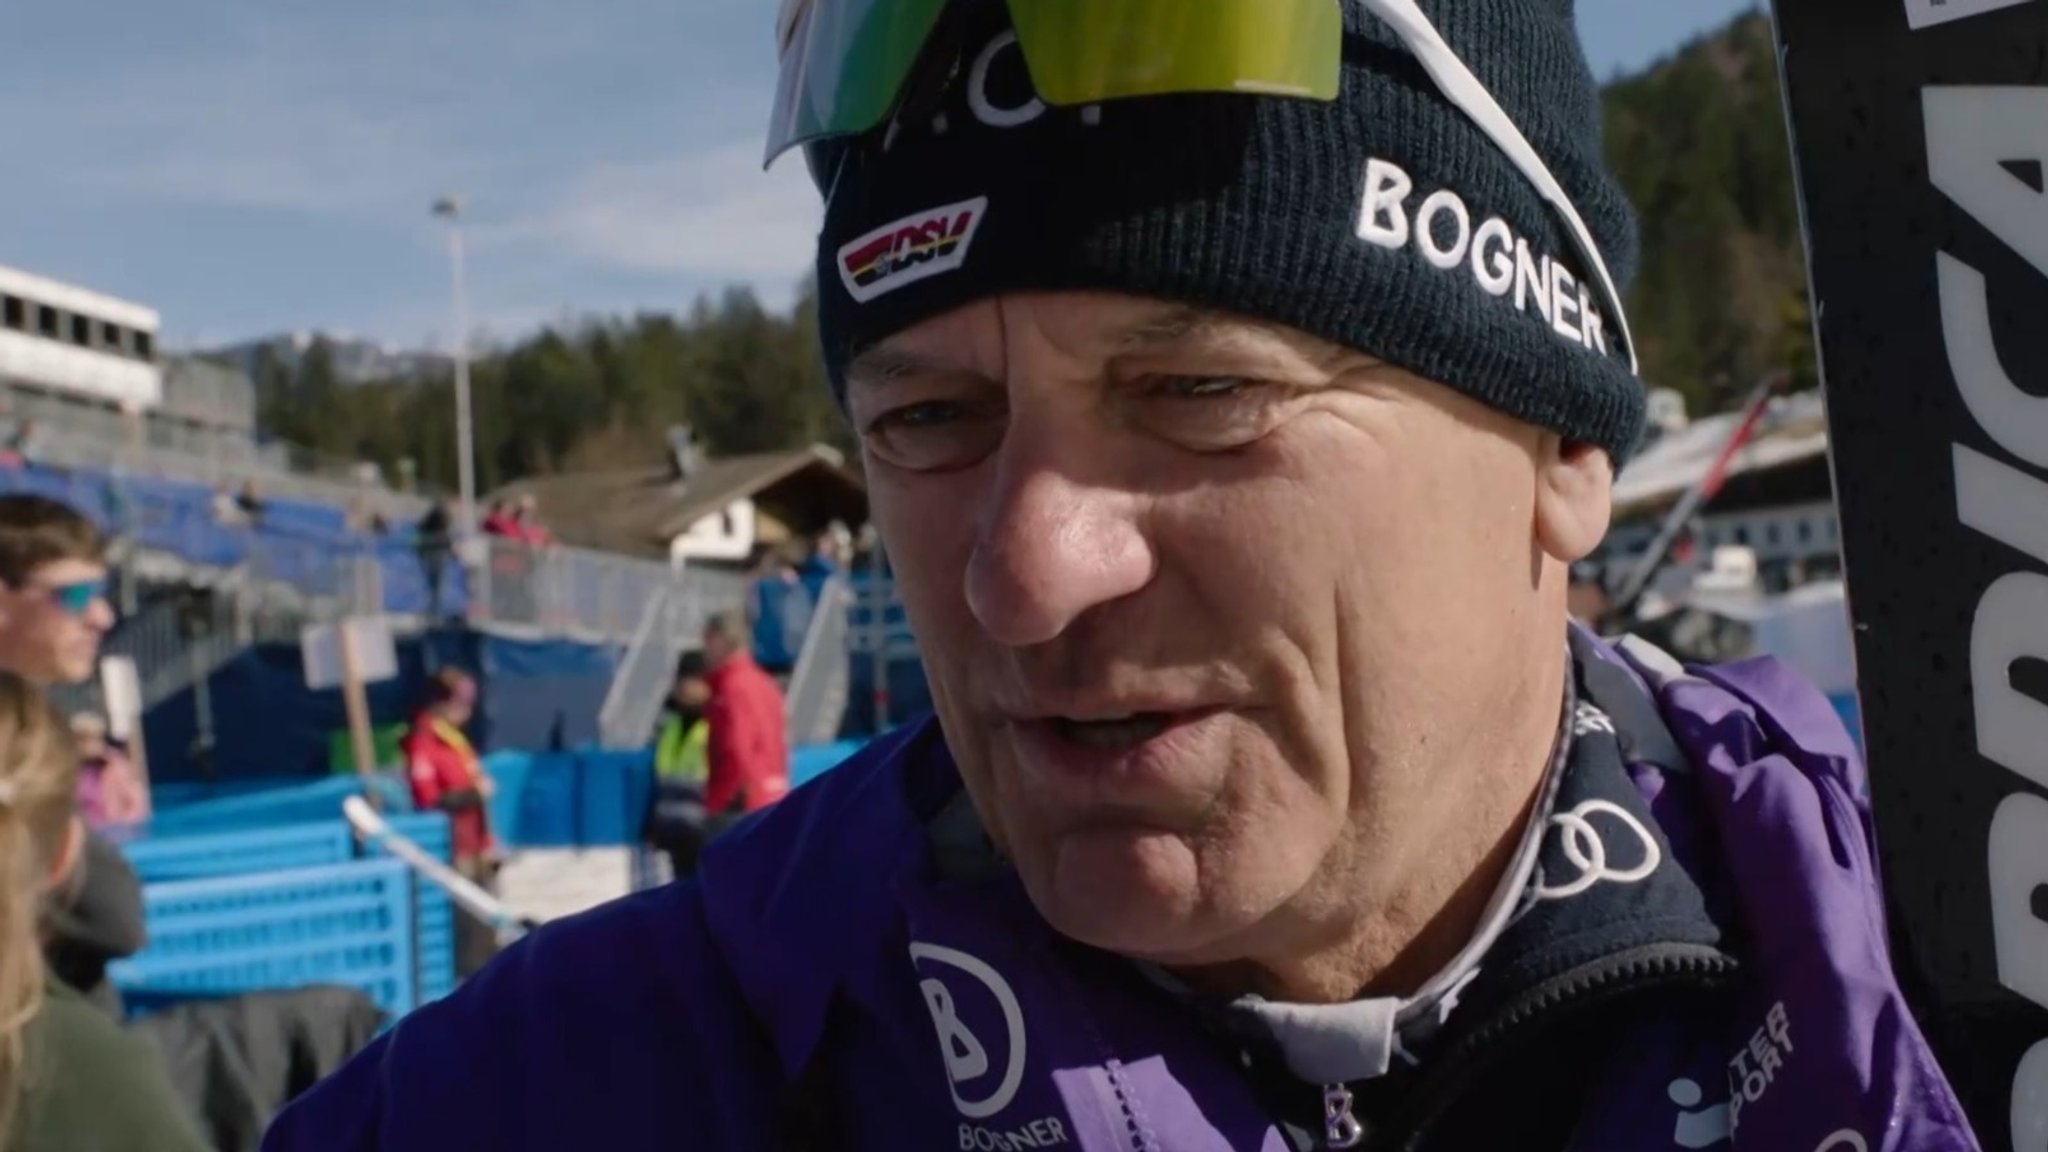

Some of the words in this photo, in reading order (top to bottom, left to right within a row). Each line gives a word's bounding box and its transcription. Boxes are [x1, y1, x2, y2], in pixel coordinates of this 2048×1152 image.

[1356, 157, 1607, 357] BOGNER
[1727, 1000, 1788, 1090] TER
[1728, 1022, 1794, 1142] PORT
[957, 1116, 1069, 1152] BOGNER
